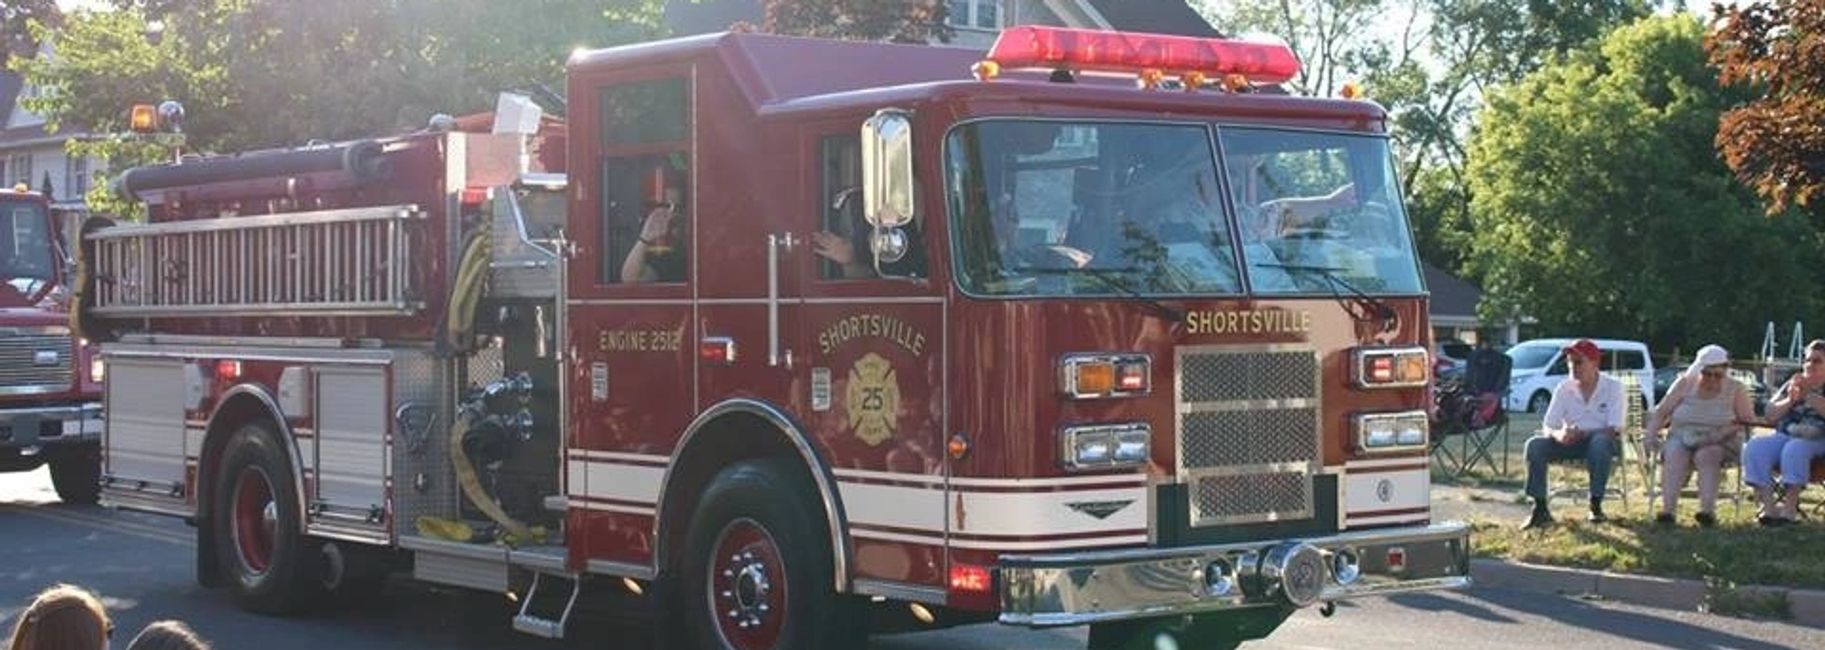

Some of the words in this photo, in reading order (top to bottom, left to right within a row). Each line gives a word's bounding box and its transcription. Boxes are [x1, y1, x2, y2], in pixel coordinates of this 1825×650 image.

[1186, 310, 1310, 334] SHORTSVILLE
[600, 330, 646, 351] ENGINE
[651, 330, 681, 351] 2512
[819, 314, 925, 356] SHORTSVILLE
[862, 387, 883, 410] 25
